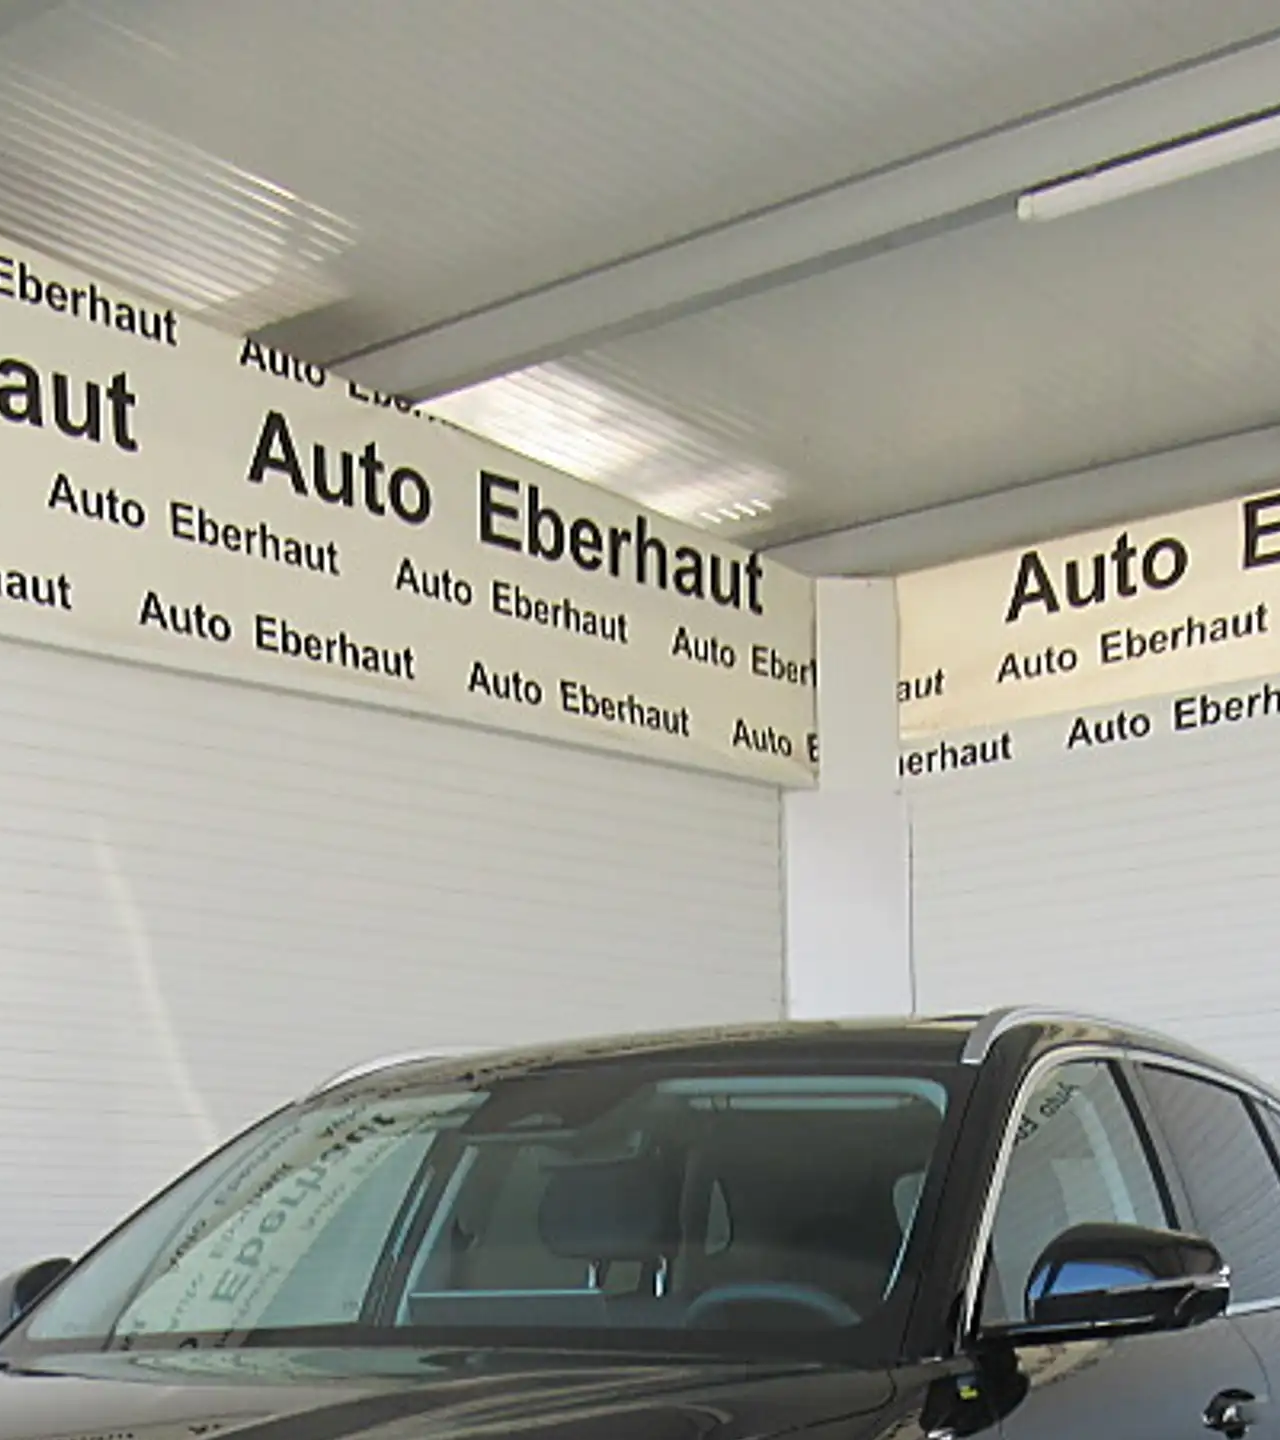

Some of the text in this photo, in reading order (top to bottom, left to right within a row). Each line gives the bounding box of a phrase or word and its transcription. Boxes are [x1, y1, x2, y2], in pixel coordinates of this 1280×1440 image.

[49, 474, 339, 575] Auto Eberhaut
[249, 410, 762, 613] Auto Eberhaut
[397, 558, 627, 643] Auto Eberhaut
[1005, 533, 1187, 623] Auto
[140, 592, 414, 679] Auto Eberhaut
[672, 627, 735, 668] Auto
[998, 604, 1267, 683] Auto Eberhaut
[469, 662, 689, 737] Auto Eberhaut
[733, 719, 792, 757] Auto
[1068, 712, 1150, 748] Auto
